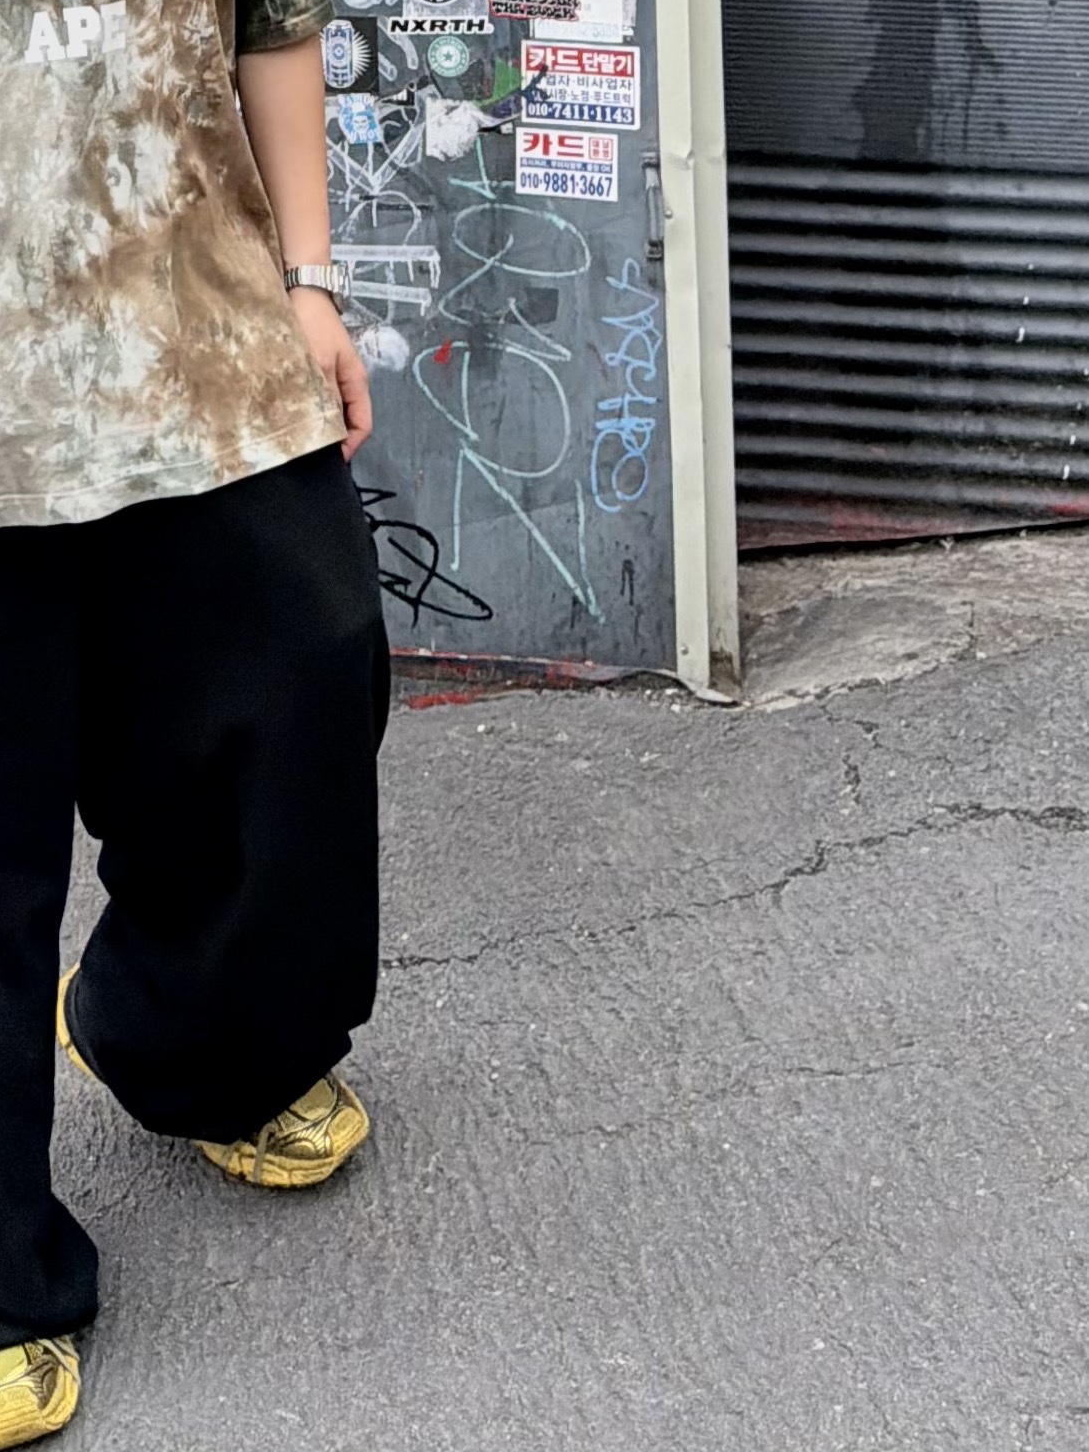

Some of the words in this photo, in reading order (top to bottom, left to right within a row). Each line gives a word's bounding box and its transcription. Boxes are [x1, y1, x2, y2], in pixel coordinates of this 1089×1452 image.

[24, 0, 127, 64] APE
[390, 19, 486, 32] NXRTH
[523, 132, 585, 158] 카드
